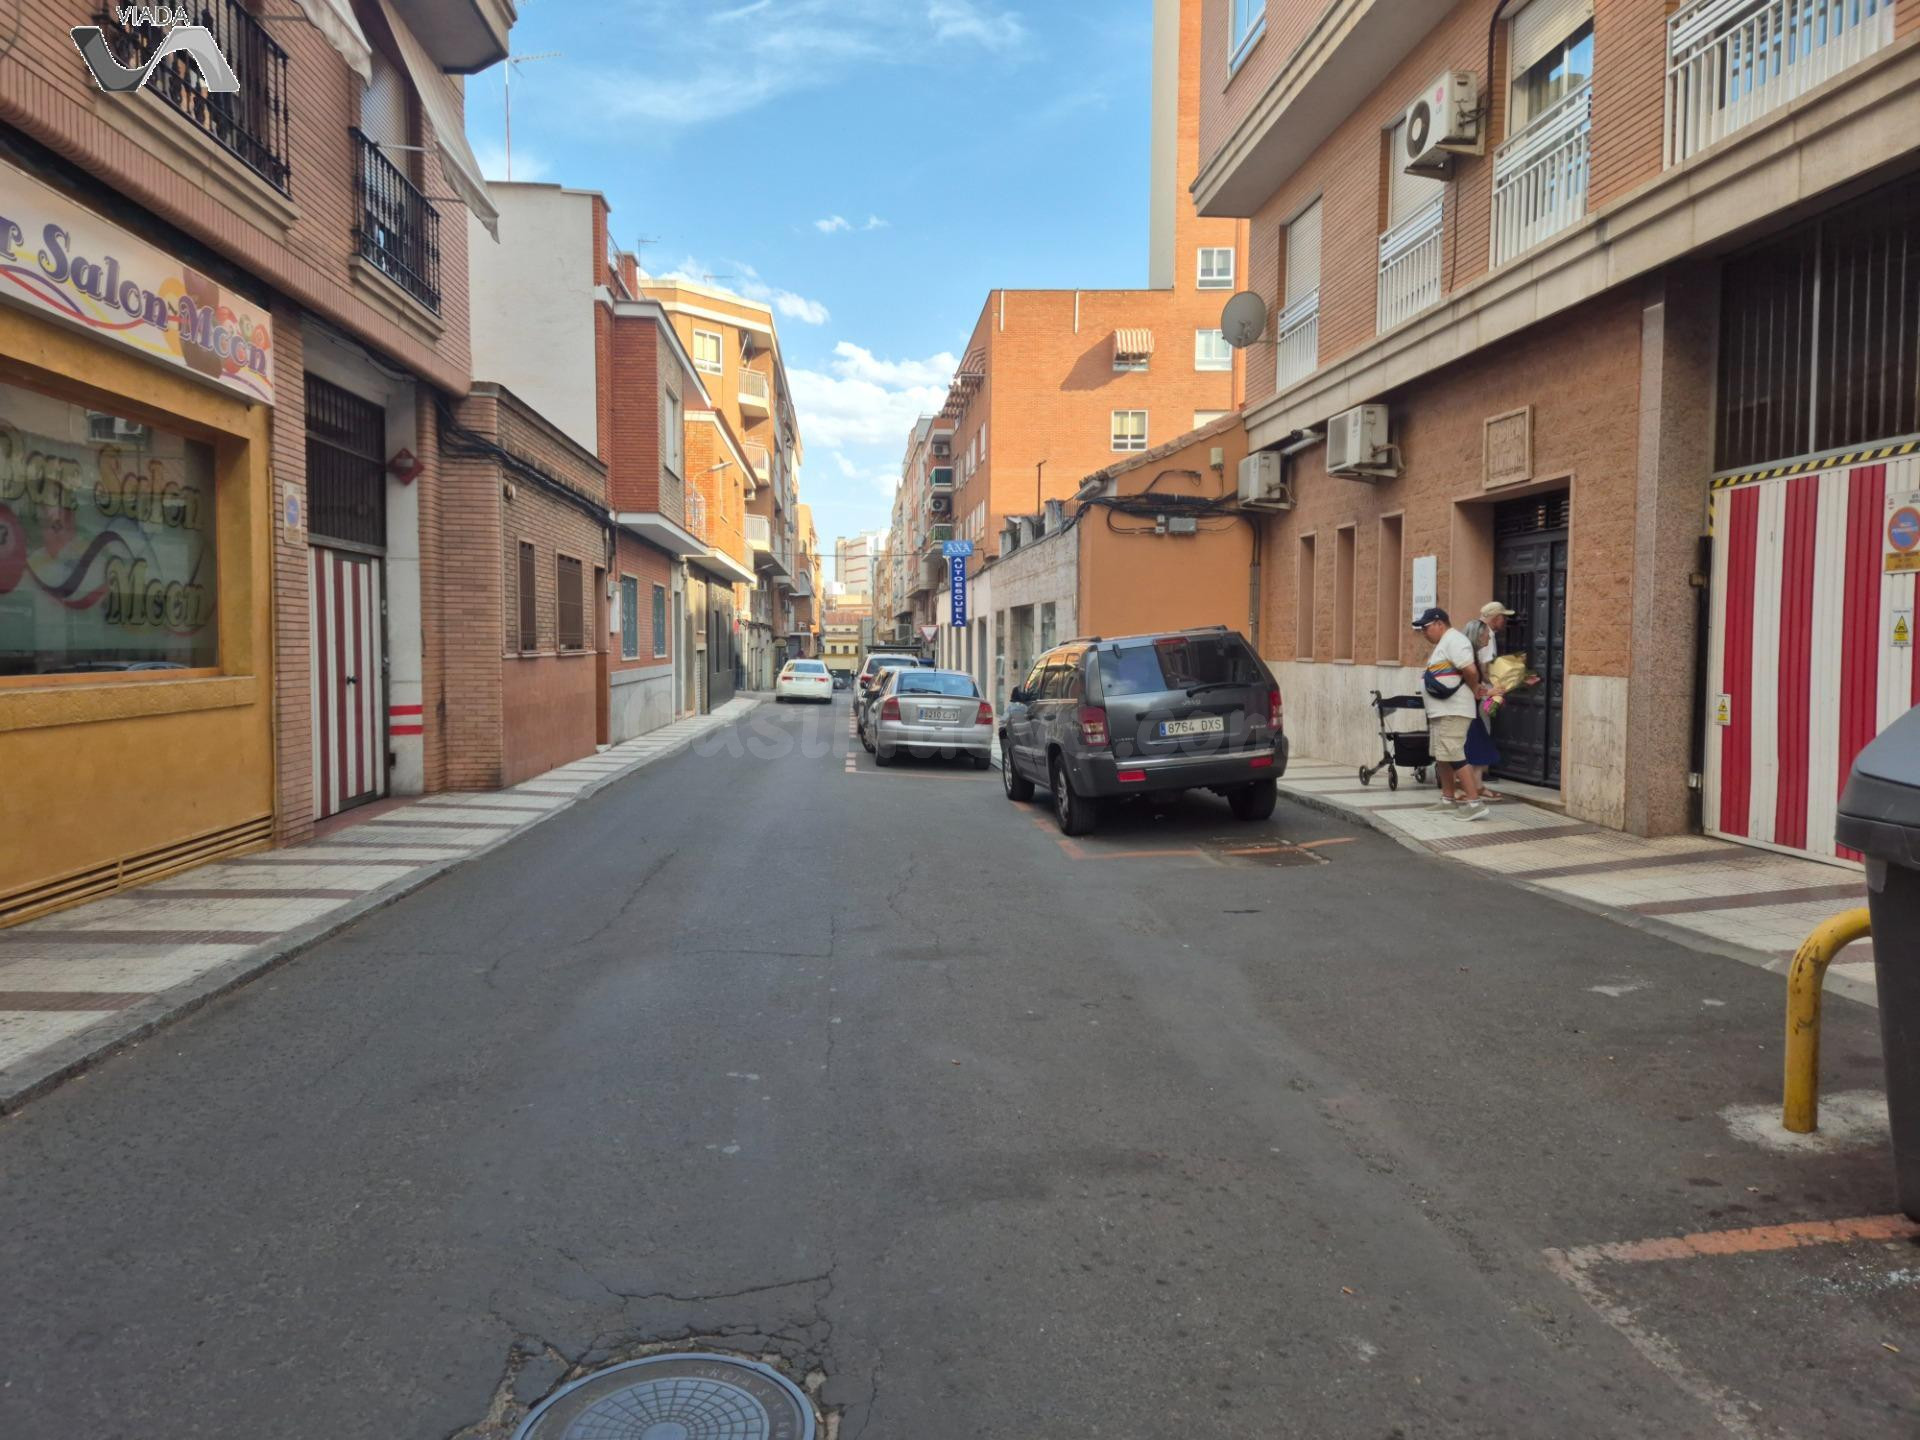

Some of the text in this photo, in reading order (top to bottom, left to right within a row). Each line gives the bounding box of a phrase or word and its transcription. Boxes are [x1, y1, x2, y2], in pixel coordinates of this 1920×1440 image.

[38, 223, 169, 332] Salon
[94, 444, 203, 530] Salon
[953, 557, 964, 625] AUTOESCUELA
[1167, 719, 1222, 734] 8764 DXS
